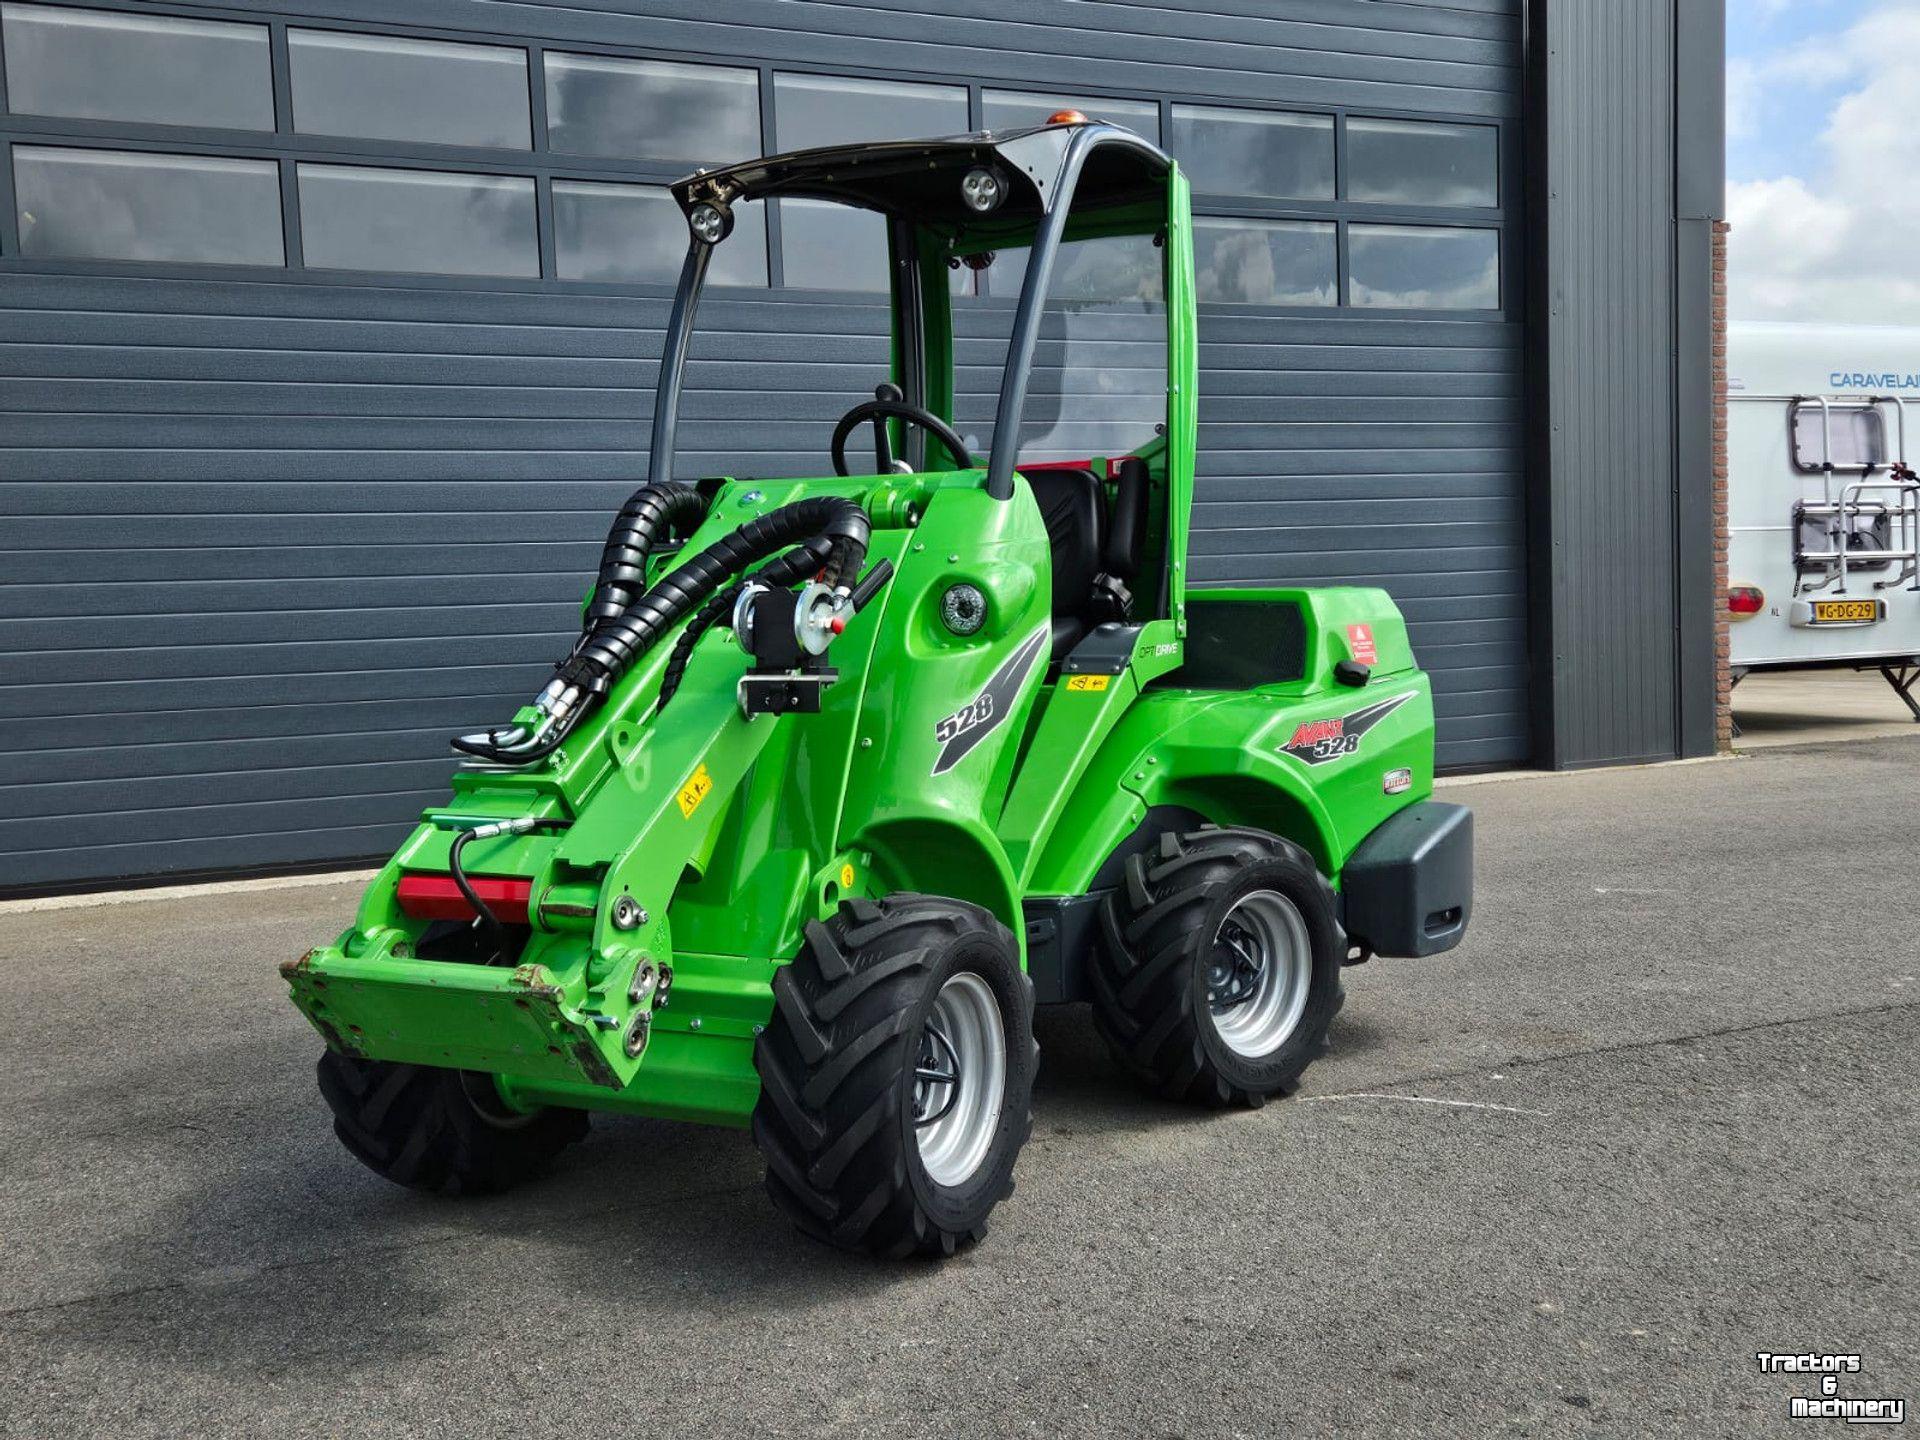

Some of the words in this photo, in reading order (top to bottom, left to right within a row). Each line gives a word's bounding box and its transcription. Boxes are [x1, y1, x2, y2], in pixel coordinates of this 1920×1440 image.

[1830, 373, 1920, 388] CARAVELAI
[1817, 604, 1871, 619] WG-DG-29
[935, 693, 993, 742] 528
[1287, 718, 1344, 750] AVANT
[1313, 733, 1360, 758] 528
